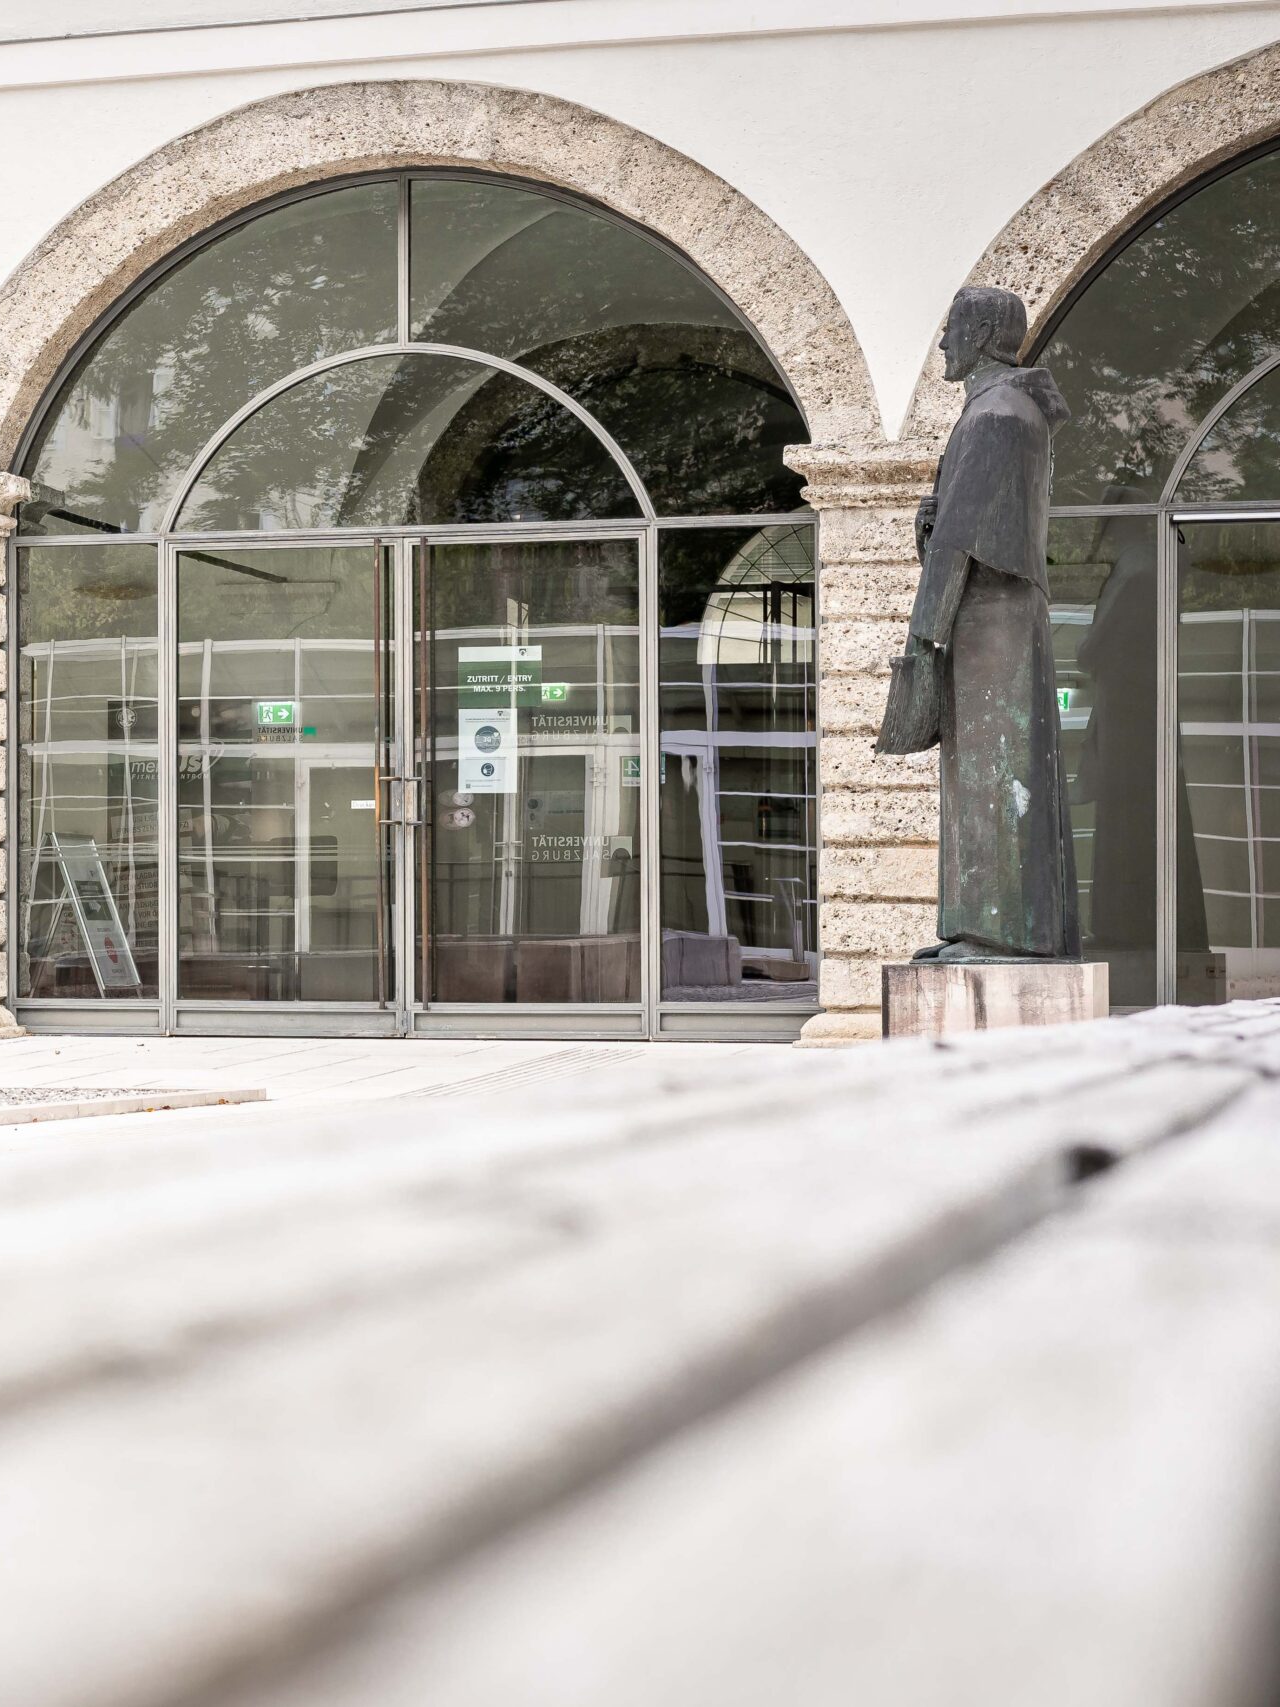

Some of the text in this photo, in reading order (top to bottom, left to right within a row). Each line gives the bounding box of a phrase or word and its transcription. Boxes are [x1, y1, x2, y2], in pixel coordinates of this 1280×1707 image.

[467, 675, 498, 683] ZUTRITT
[507, 674, 533, 682] ENTRY
[473, 685, 494, 693] MAX.
